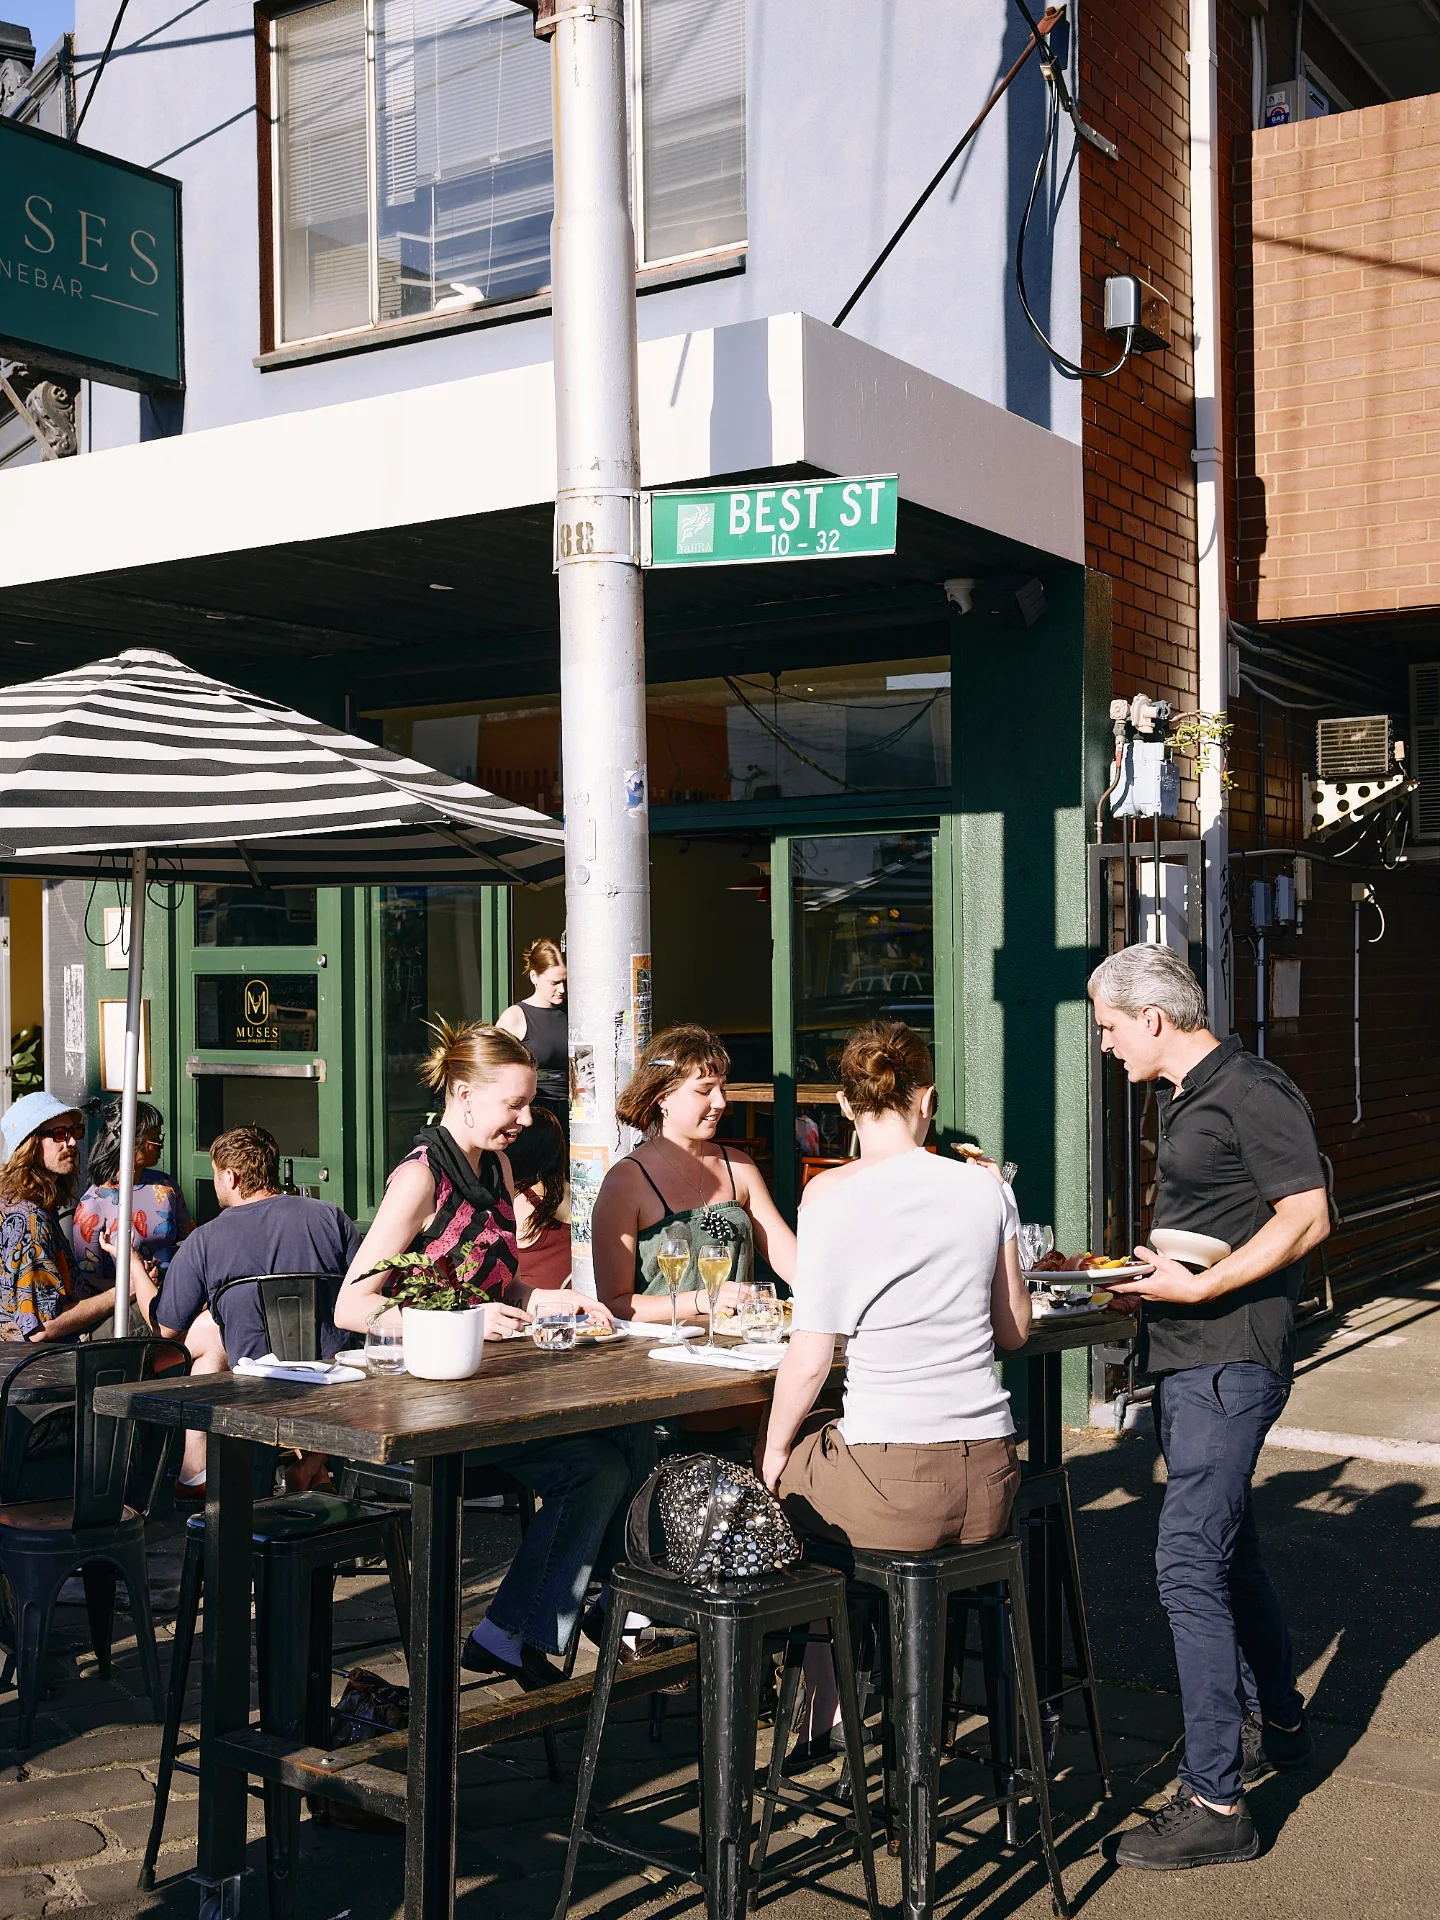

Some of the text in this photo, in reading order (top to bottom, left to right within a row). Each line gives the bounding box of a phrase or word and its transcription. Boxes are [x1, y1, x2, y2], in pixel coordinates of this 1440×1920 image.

[25, 195, 159, 285] SES
[729, 481, 886, 535] BEST ST
[771, 532, 790, 556] 10
[816, 529, 840, 553] 32
[236, 1027, 279, 1038] MUSES
